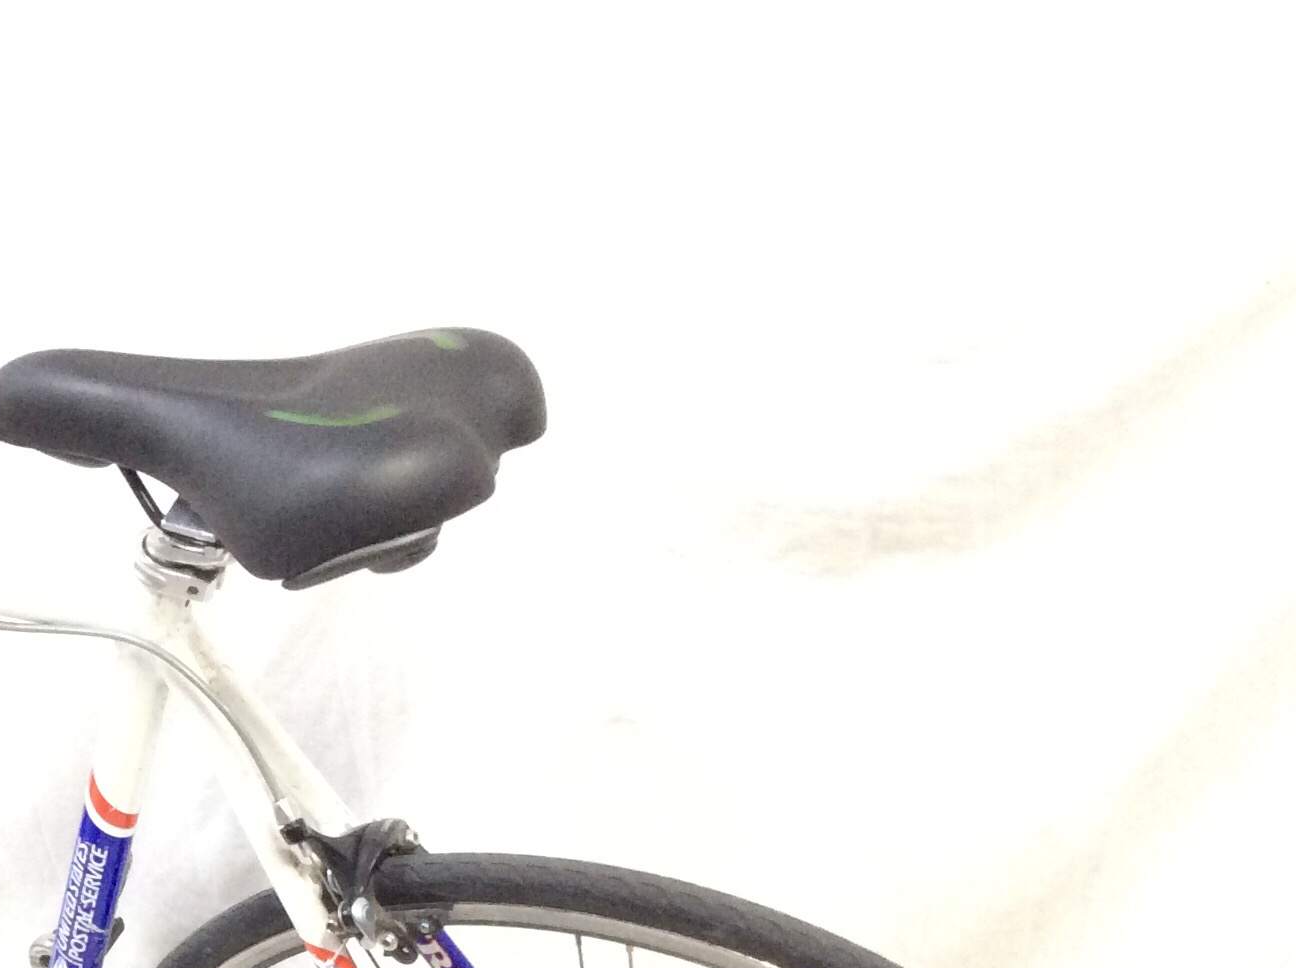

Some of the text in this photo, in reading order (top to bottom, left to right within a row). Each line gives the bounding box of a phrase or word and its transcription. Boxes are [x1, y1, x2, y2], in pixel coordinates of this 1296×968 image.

[57, 892, 77, 953] UNITED
[68, 843, 109, 962] POSTAL SERVICE
